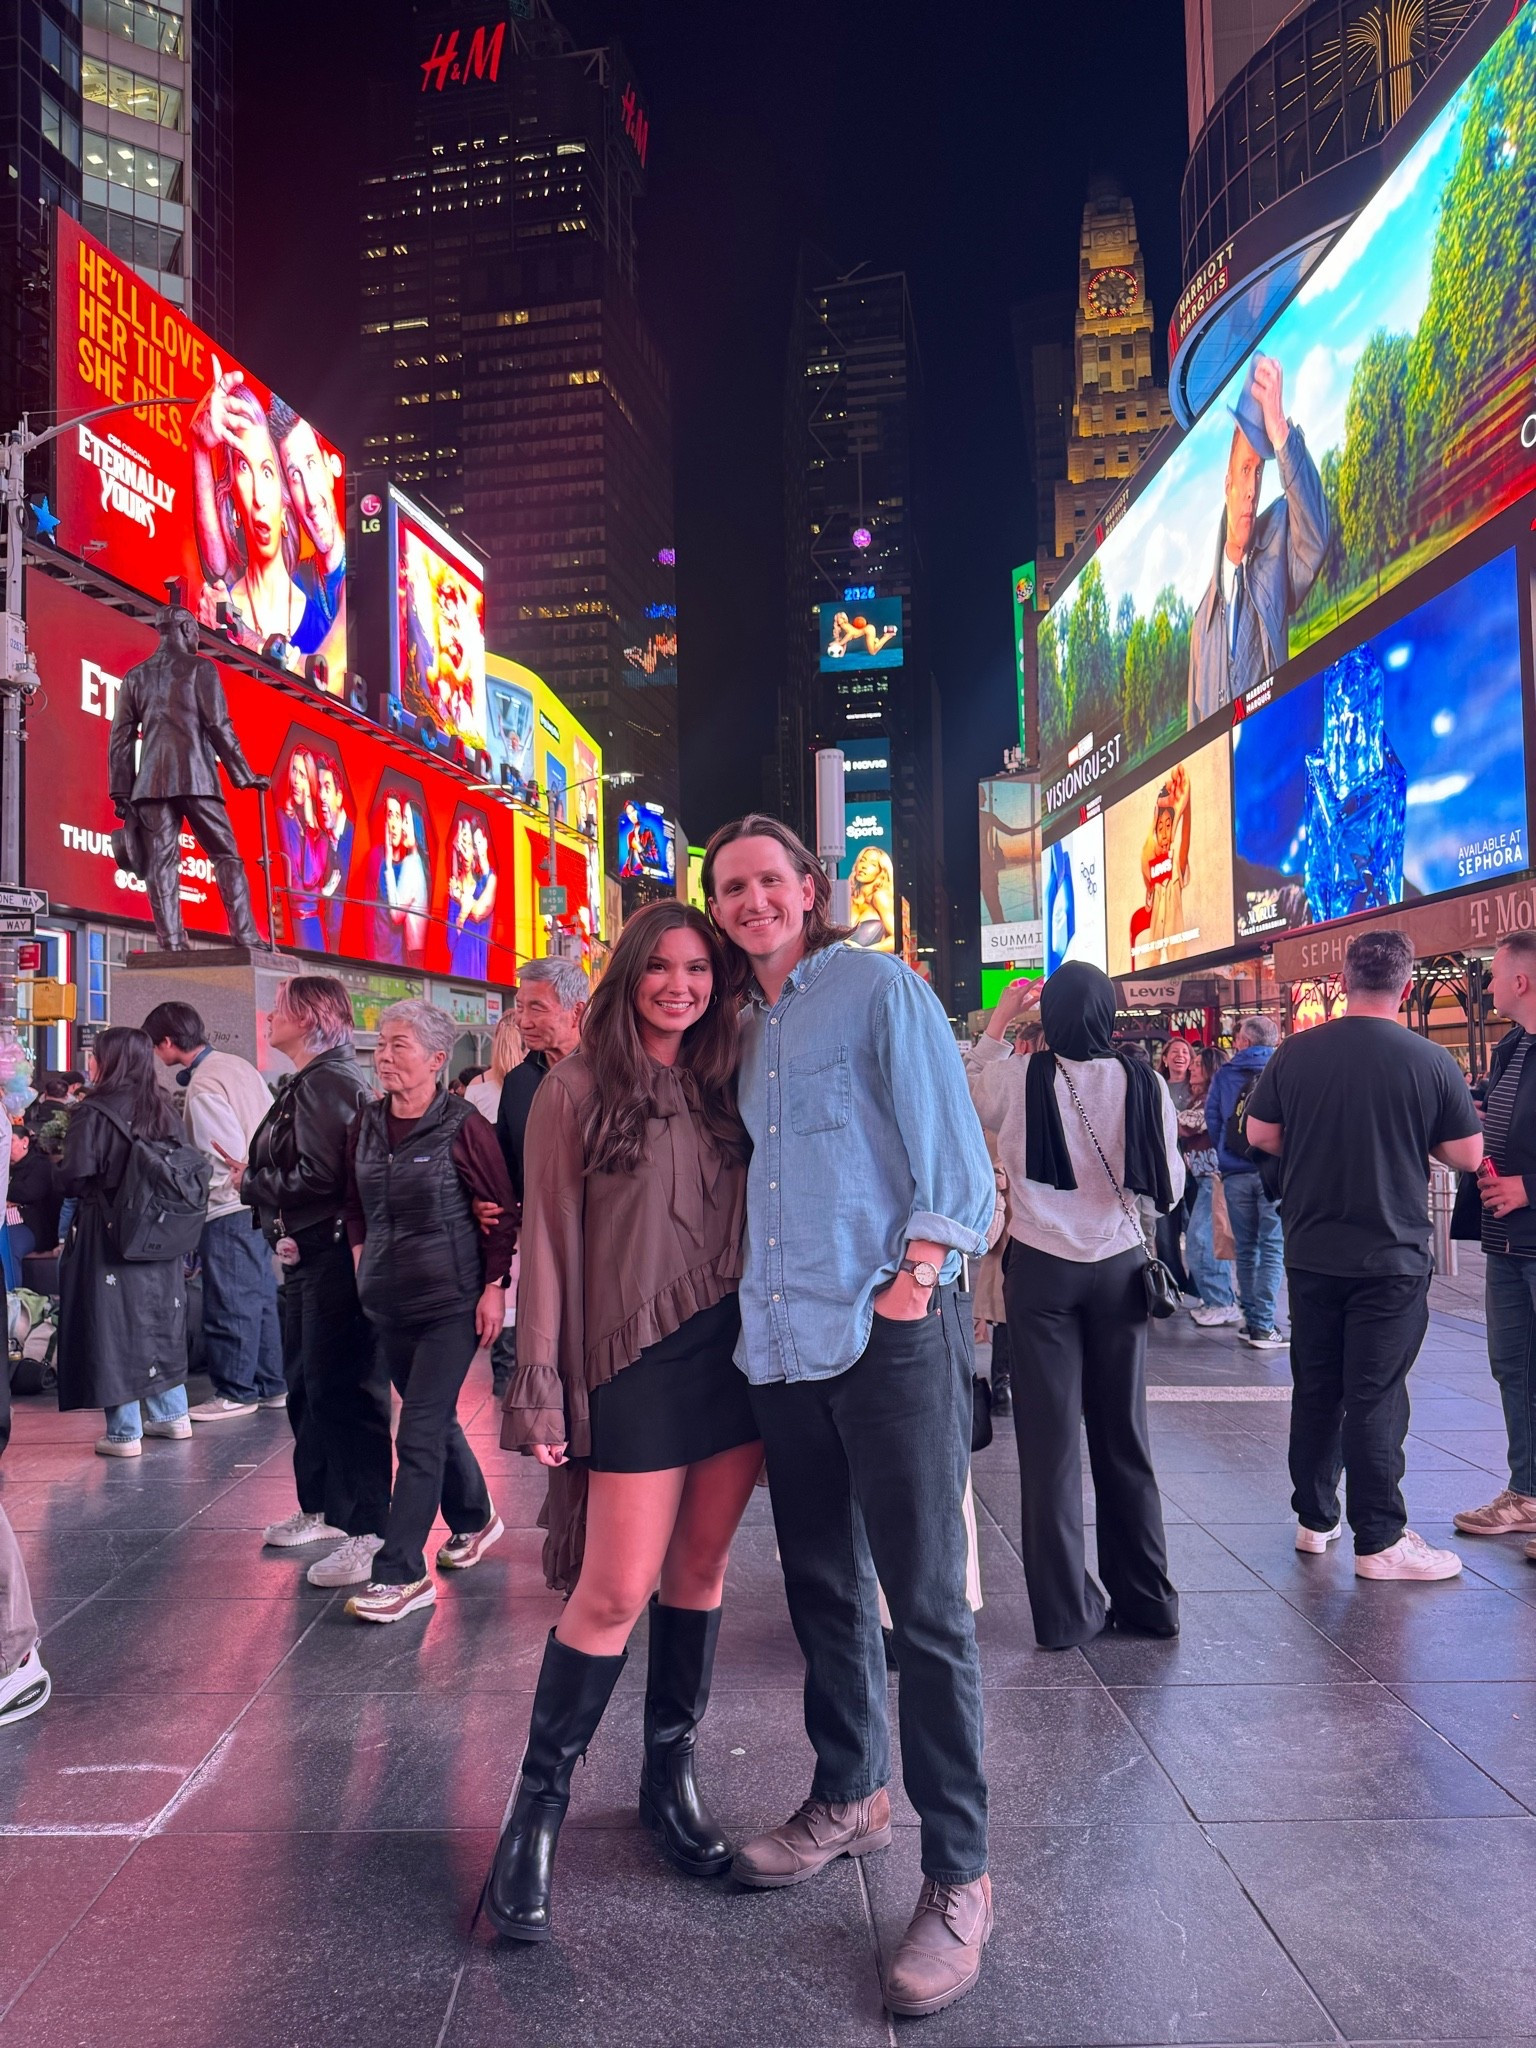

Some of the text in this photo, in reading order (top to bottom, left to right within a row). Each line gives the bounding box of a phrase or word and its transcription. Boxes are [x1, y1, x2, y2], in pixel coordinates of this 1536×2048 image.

[420, 22, 506, 92] H&M
[1179, 242, 1235, 318] MARRIOTT
[79, 240, 205, 382] HE'LL LOVE
[1180, 272, 1227, 338] MARQUIS
[79, 287, 177, 400] HER TILL
[78, 336, 127, 406] SHE
[78, 423, 177, 513] ETERNALLY
[98, 467, 156, 538] YOURS
[361, 518, 381, 533] LG
[844, 585, 876, 602] 2026
[1046, 733, 1122, 814] VISIONQUEST
[846, 826, 884, 840] Sports
[852, 815, 877, 828] Just
[1458, 828, 1521, 861] AVAILABLE AT
[1458, 844, 1523, 877] SEPHORA
[21, 896, 38, 907] WAY
[6, 920, 27, 931] WAY
[991, 932, 1043, 948] SUMMI
[1301, 934, 1356, 969] SEPHO
